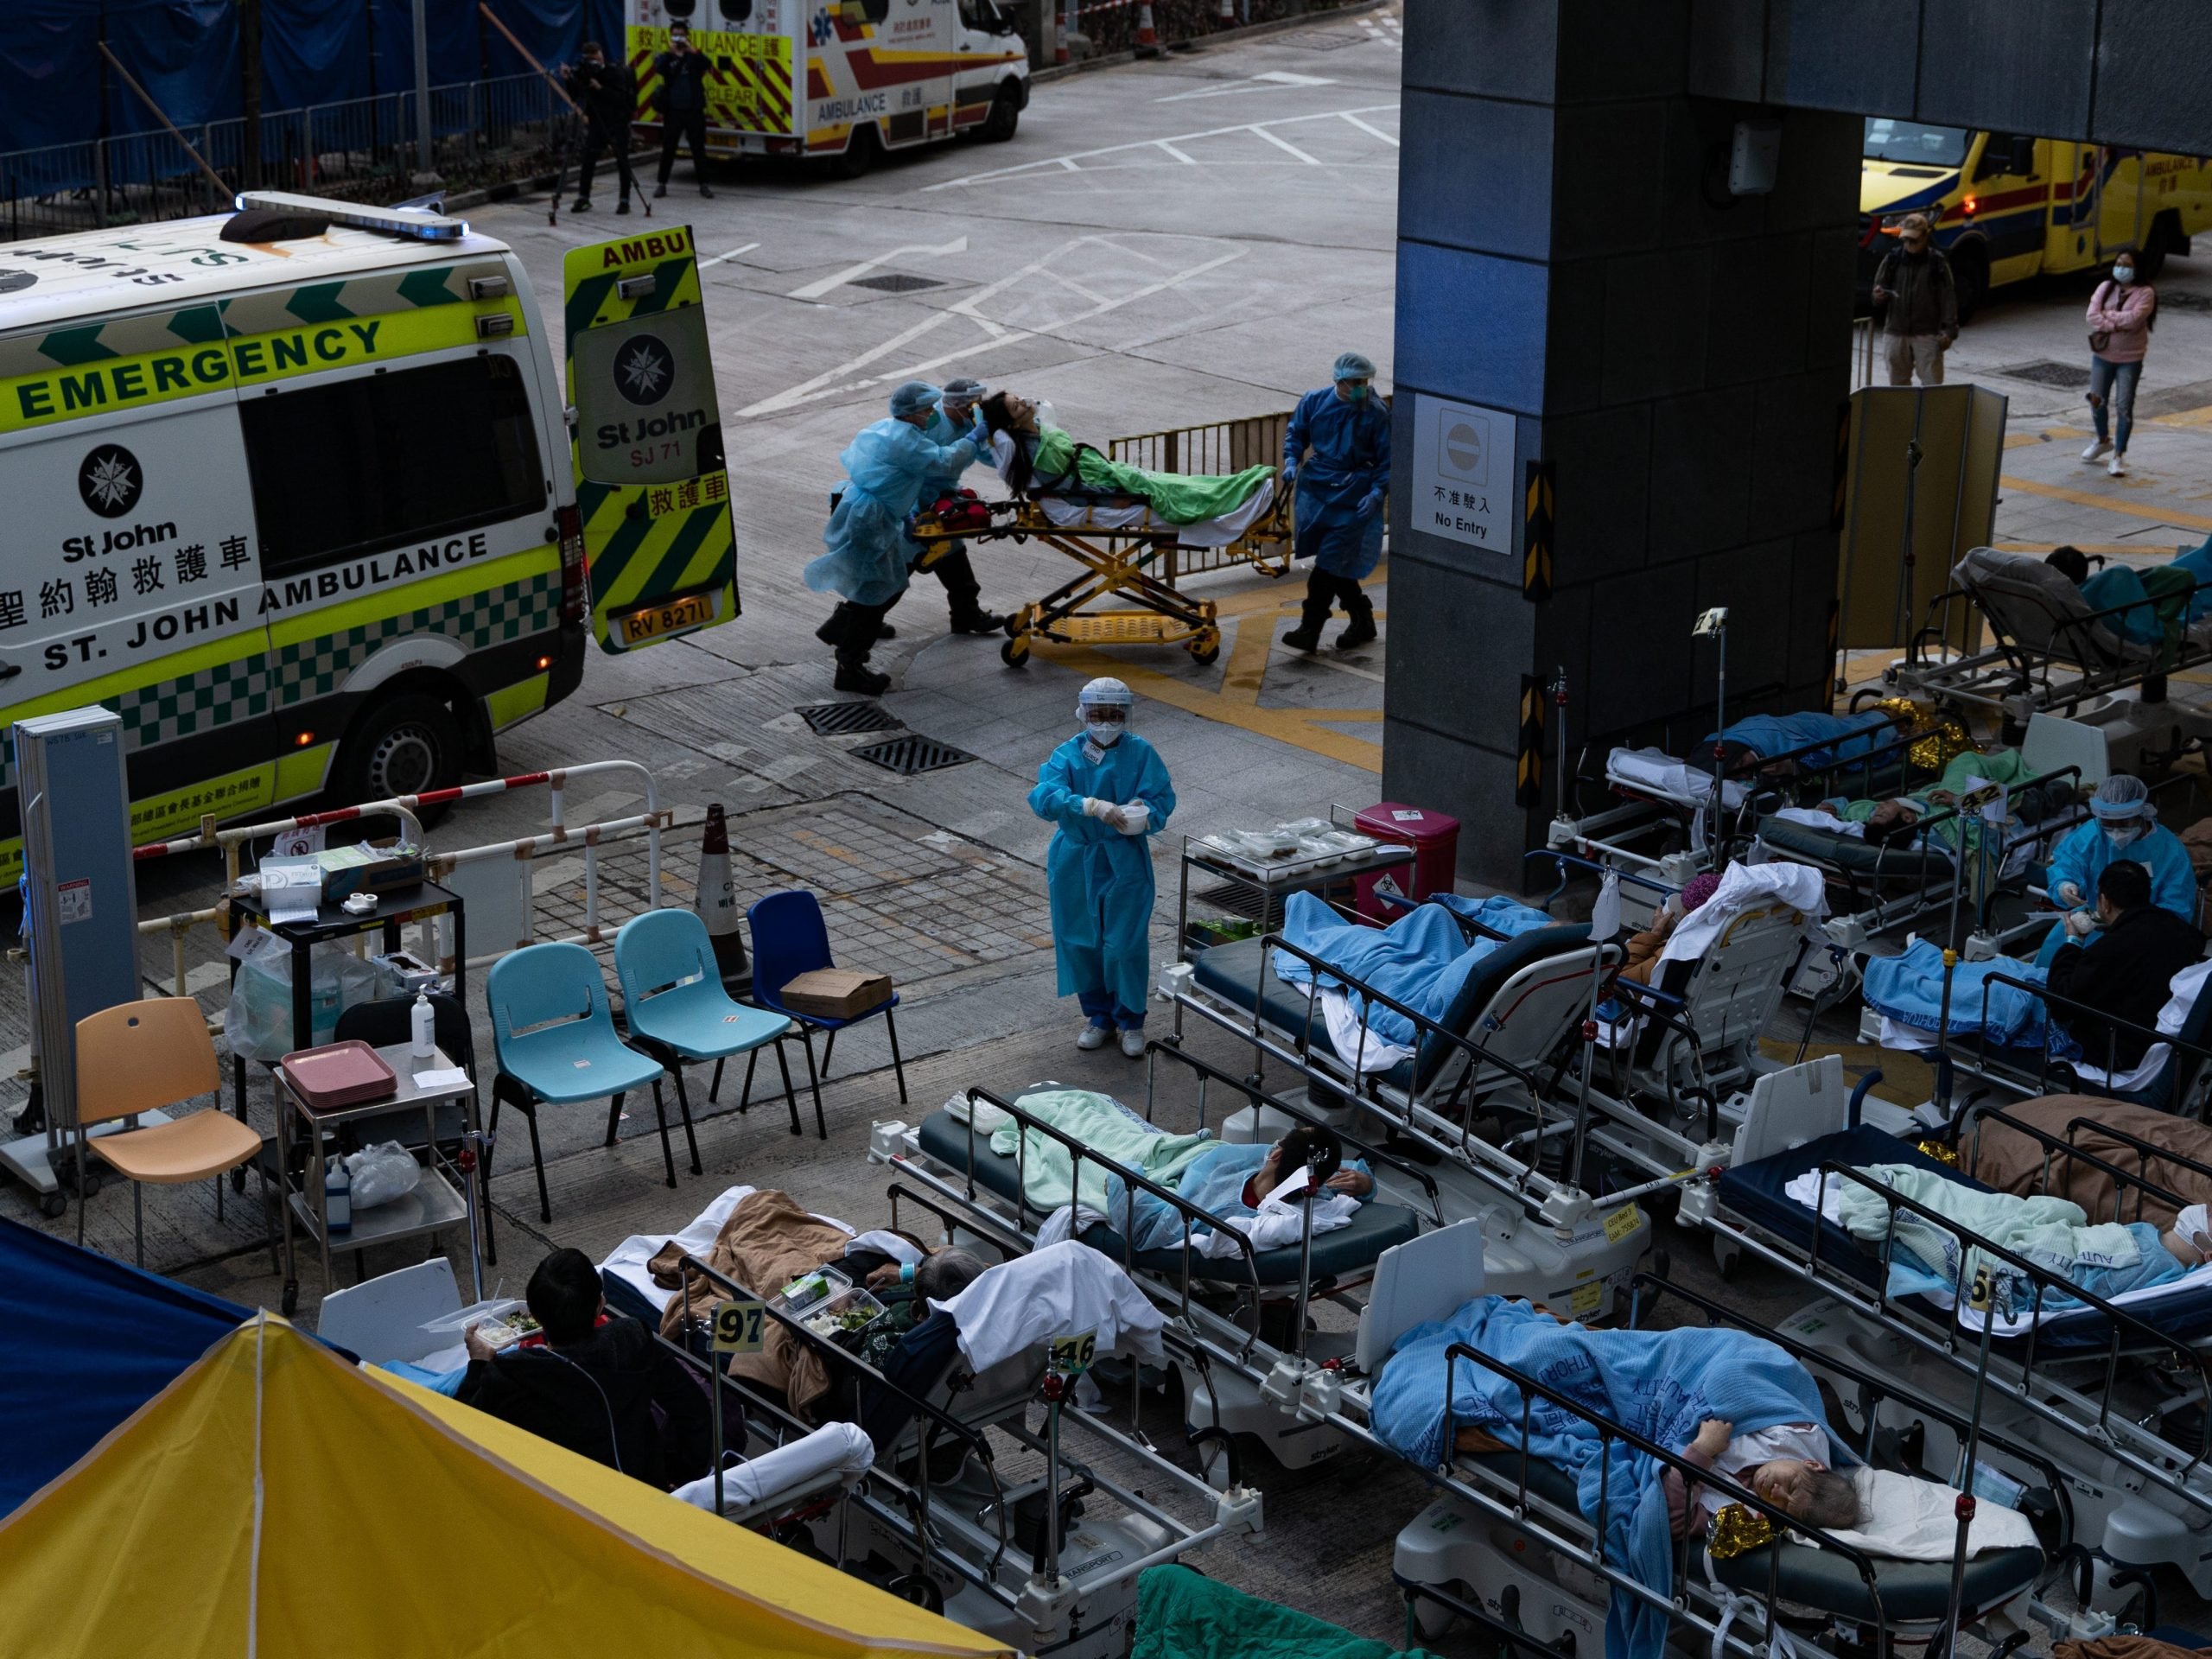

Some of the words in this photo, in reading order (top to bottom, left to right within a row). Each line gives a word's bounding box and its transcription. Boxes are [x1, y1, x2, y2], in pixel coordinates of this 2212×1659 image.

[706, 86, 753, 104] CLEAR
[818, 92, 886, 120] AMBULANCE
[603, 232, 685, 268] AMBU
[16, 321, 381, 419] EMERGENCY
[597, 422, 630, 449] St
[635, 408, 707, 442] John
[630, 446, 654, 467] SJ
[661, 441, 681, 461] 71
[650, 475, 727, 516] 救護車
[1434, 486, 1491, 514] 不准駛入
[1435, 512, 1452, 528] No
[1456, 517, 1487, 540] Entry
[62, 536, 96, 563] St
[102, 521, 178, 555] John
[0, 535, 251, 630] 聖約翰救護車
[44, 634, 107, 671] ST.
[127, 598, 239, 649] JOHN
[257, 533, 487, 615] AMBULANCE
[630, 614, 655, 639] RV
[663, 603, 705, 629] 8271
[1962, 785, 2000, 808] 42
[60, 879, 89, 891] WARNING
[718, 1308, 763, 1344] 97
[1575, 1308, 1601, 1323] stryker
[1056, 1336, 1096, 1364] 46
[1310, 1443, 1340, 1462] stryker
[1064, 1554, 1114, 1580] RANSPORT
